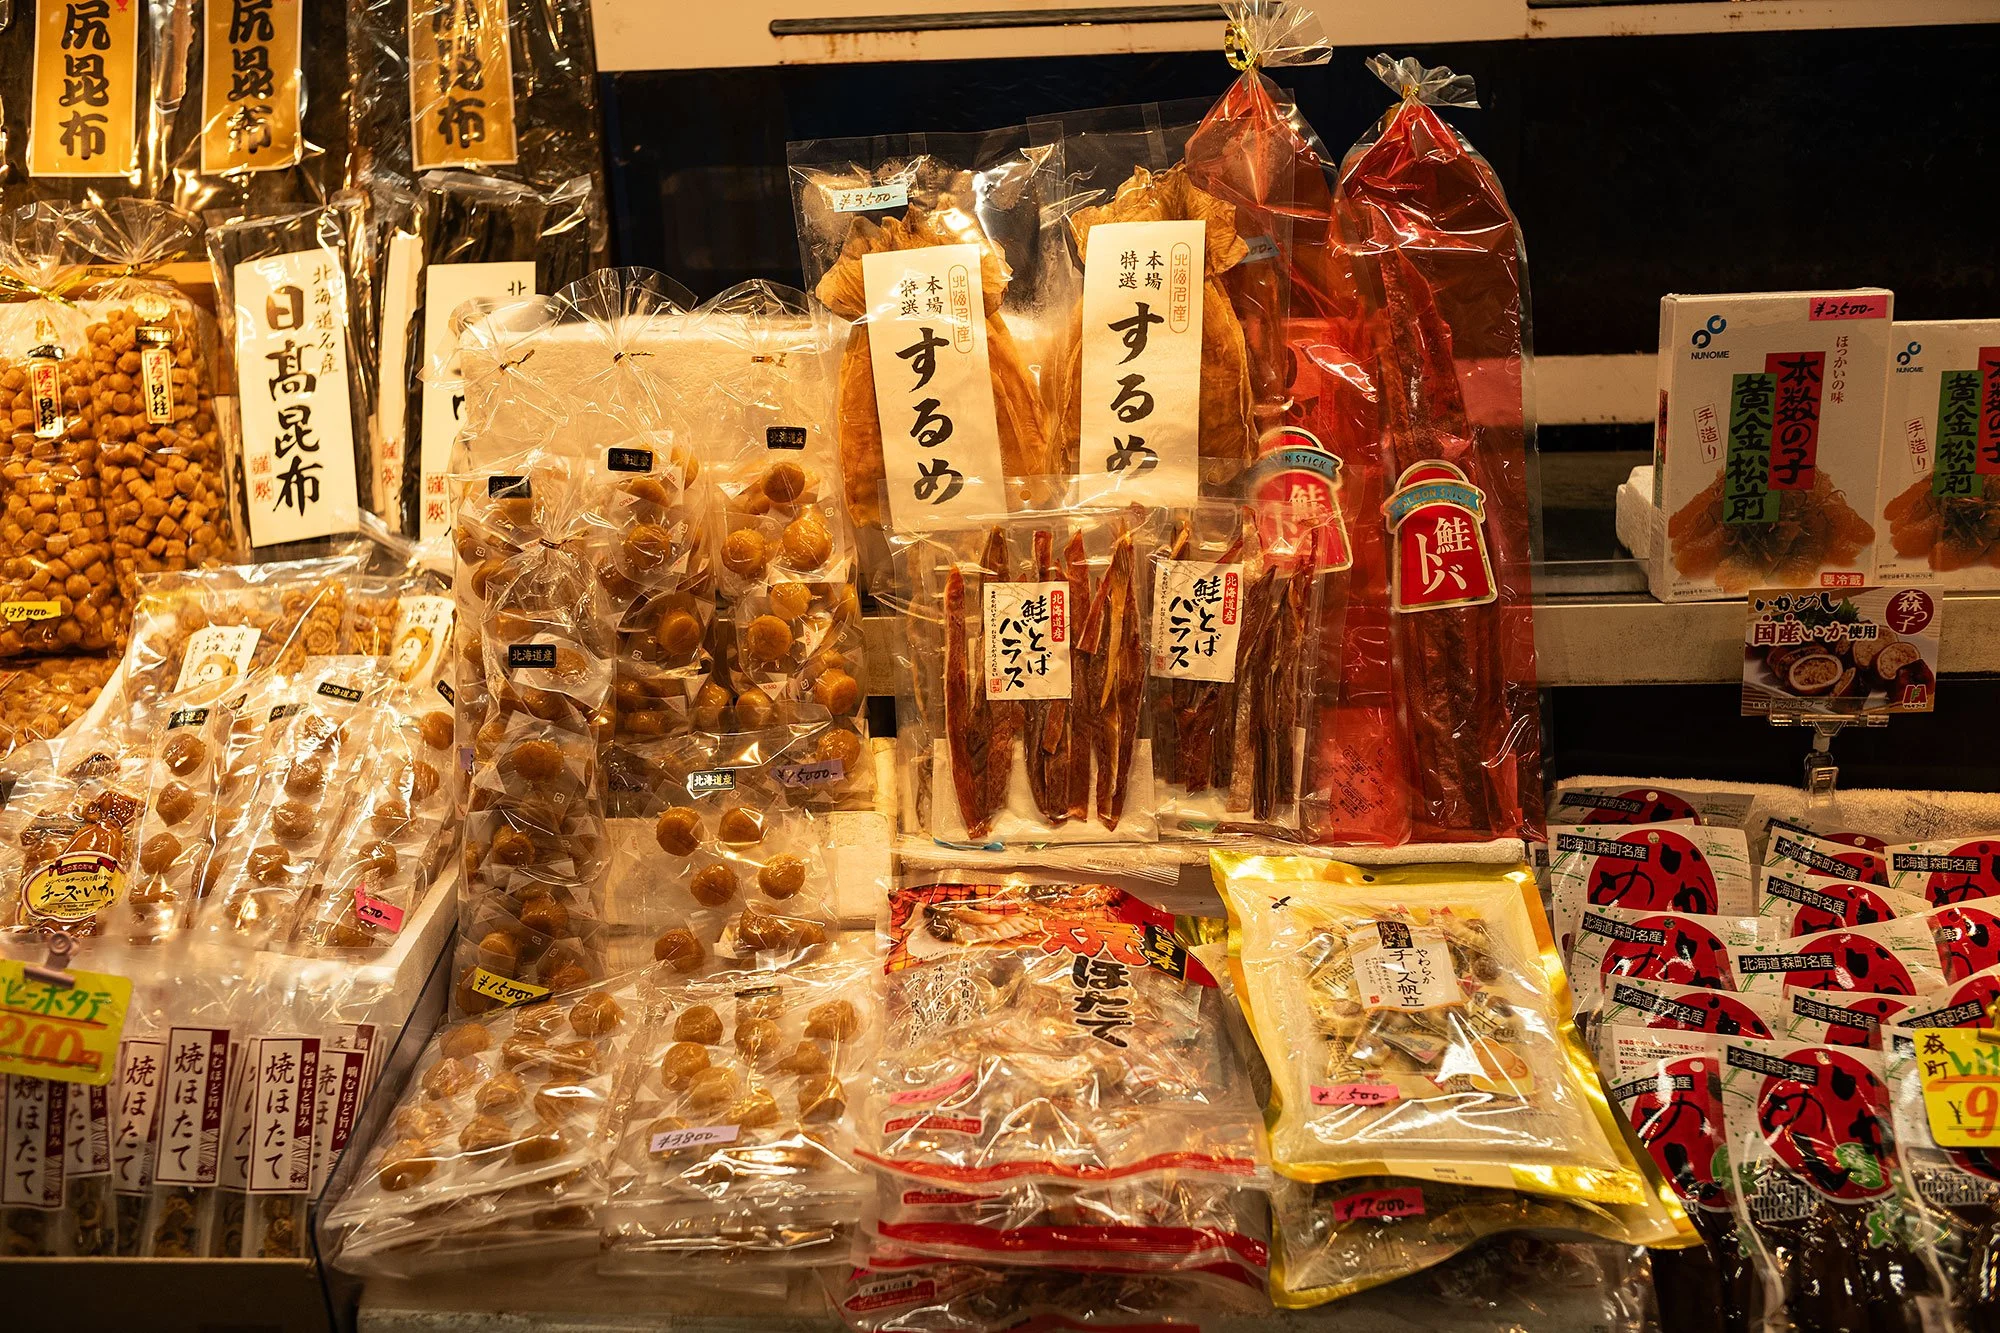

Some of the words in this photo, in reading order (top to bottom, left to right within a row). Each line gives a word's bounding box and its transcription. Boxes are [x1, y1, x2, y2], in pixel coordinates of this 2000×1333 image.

[925, 275, 944, 314] 本場
[1118, 249, 1140, 290] 特選
[1144, 249, 1165, 291] 本場
[1690, 350, 1730, 360] NUNOME
[1830, 335, 1849, 405] ほっかいの味
[1104, 301, 1166, 474] するめ
[895, 326, 965, 506] するめ
[1698, 407, 1719, 460] 手造り
[1773, 354, 1821, 485] 本数の子
[1938, 372, 1980, 496] 黄金松前
[1295, 454, 1327, 470] STICK
[1727, 373, 1775, 522] 黄金松前
[1907, 419, 1928, 471] 手造り
[618, 497, 635, 508] OPEN
[1433, 516, 1473, 555] 鮭
[1415, 532, 1468, 596] トバ
[1823, 573, 1864, 587] 要冷蔵
[1051, 593, 1064, 641] 北海道産
[1192, 575, 1223, 658] 鮭とば
[1223, 574, 1237, 623] 北海道産
[1896, 590, 1928, 633] 森っ子
[512, 649, 553, 662] 北海道産
[999, 617, 1025, 692] ハラス
[1020, 594, 1052, 677] 鮭とば
[1168, 596, 1193, 670] ハラス
[1753, 620, 1878, 646] 国産いか使用
[693, 772, 734, 787] 北海道産
[40, 881, 115, 903] チーズいか
[1389, 949, 1425, 1007] チーズ帆立
[1415, 948, 1436, 985] やわらか
[1922, 1033, 1950, 1080] 森町
[114, 1055, 156, 1182] 焼ほたて
[171, 1042, 205, 1172] 焼ほたて
[264, 1052, 296, 1180] 焼ほたて
